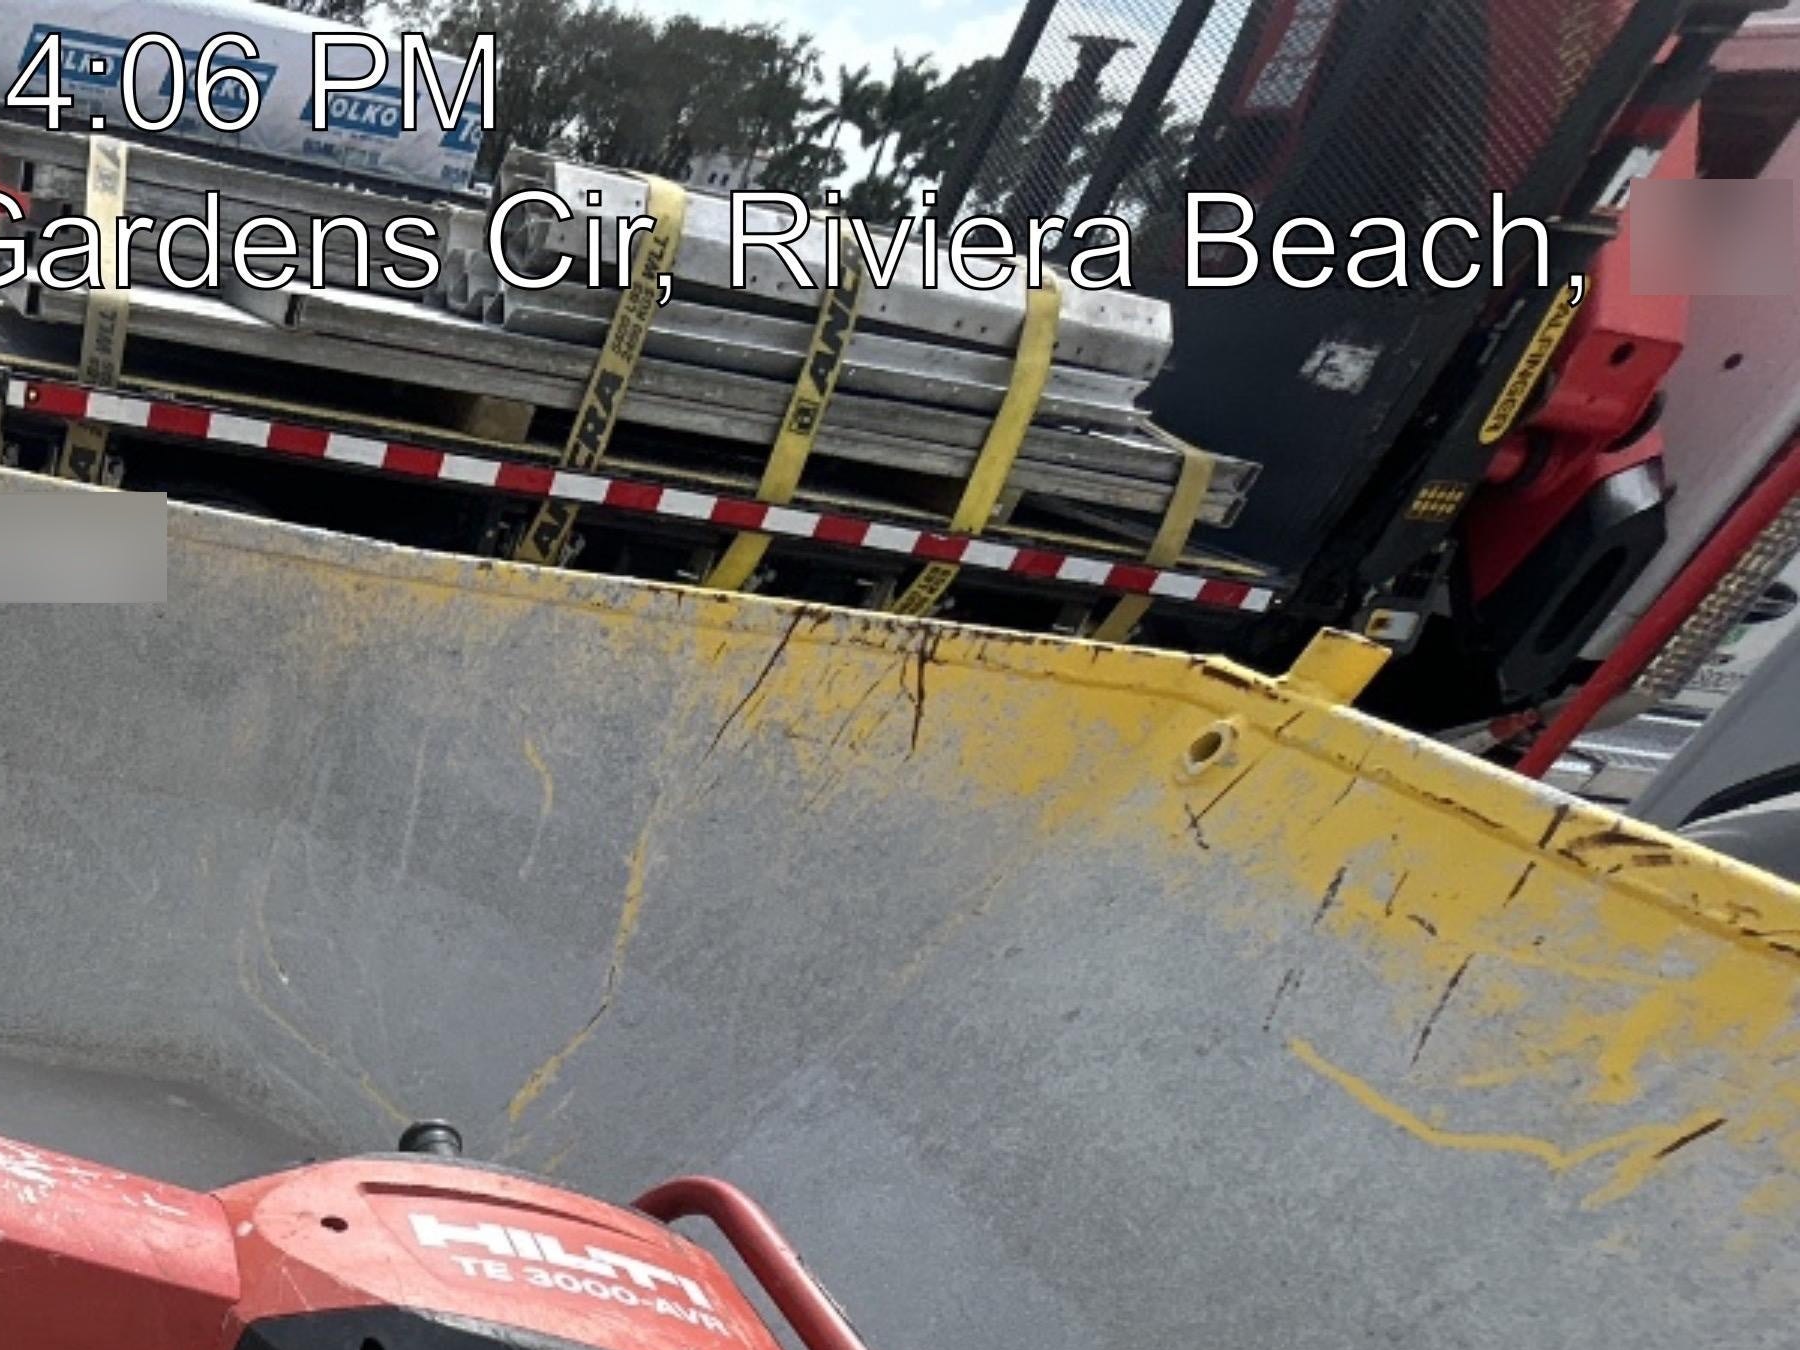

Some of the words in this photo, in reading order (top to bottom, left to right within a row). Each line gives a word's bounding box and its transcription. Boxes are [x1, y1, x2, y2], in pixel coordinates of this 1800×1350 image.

[326, 94, 398, 128] OLKO
[407, 1213, 713, 1311] HILTI
[450, 1254, 514, 1283] TE
